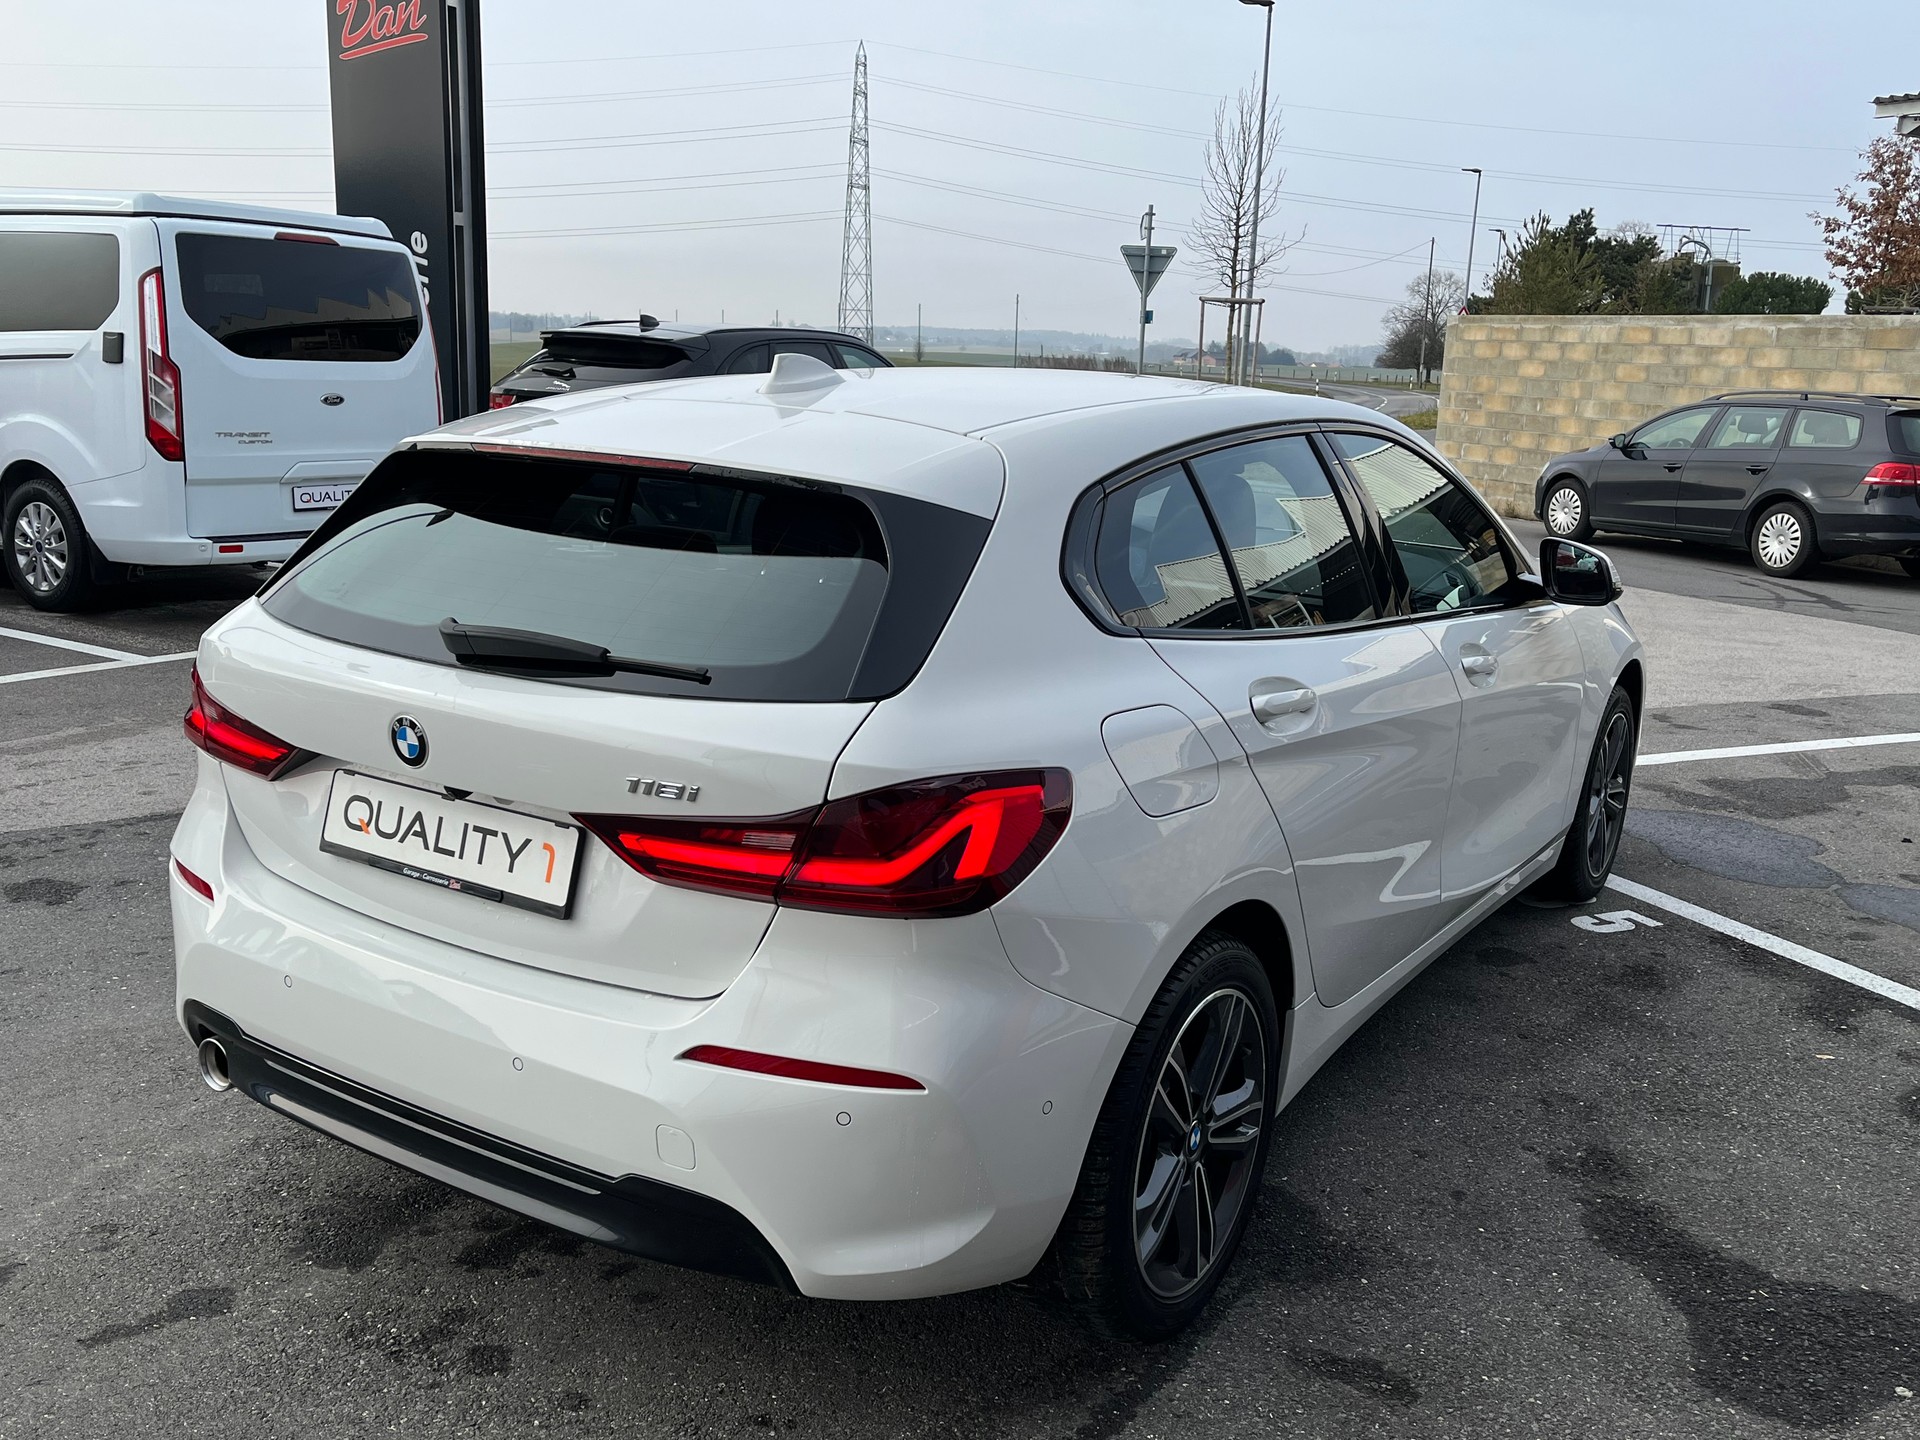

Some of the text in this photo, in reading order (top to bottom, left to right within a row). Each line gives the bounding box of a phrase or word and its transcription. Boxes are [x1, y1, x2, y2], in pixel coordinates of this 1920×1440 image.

[336, 0, 427, 48] Dan
[393, 717, 423, 737] BMW
[625, 776, 700, 802] 118i
[344, 794, 532, 874] QUALITY
[402, 867, 420, 878] Garage
[1570, 909, 1664, 933] 5
